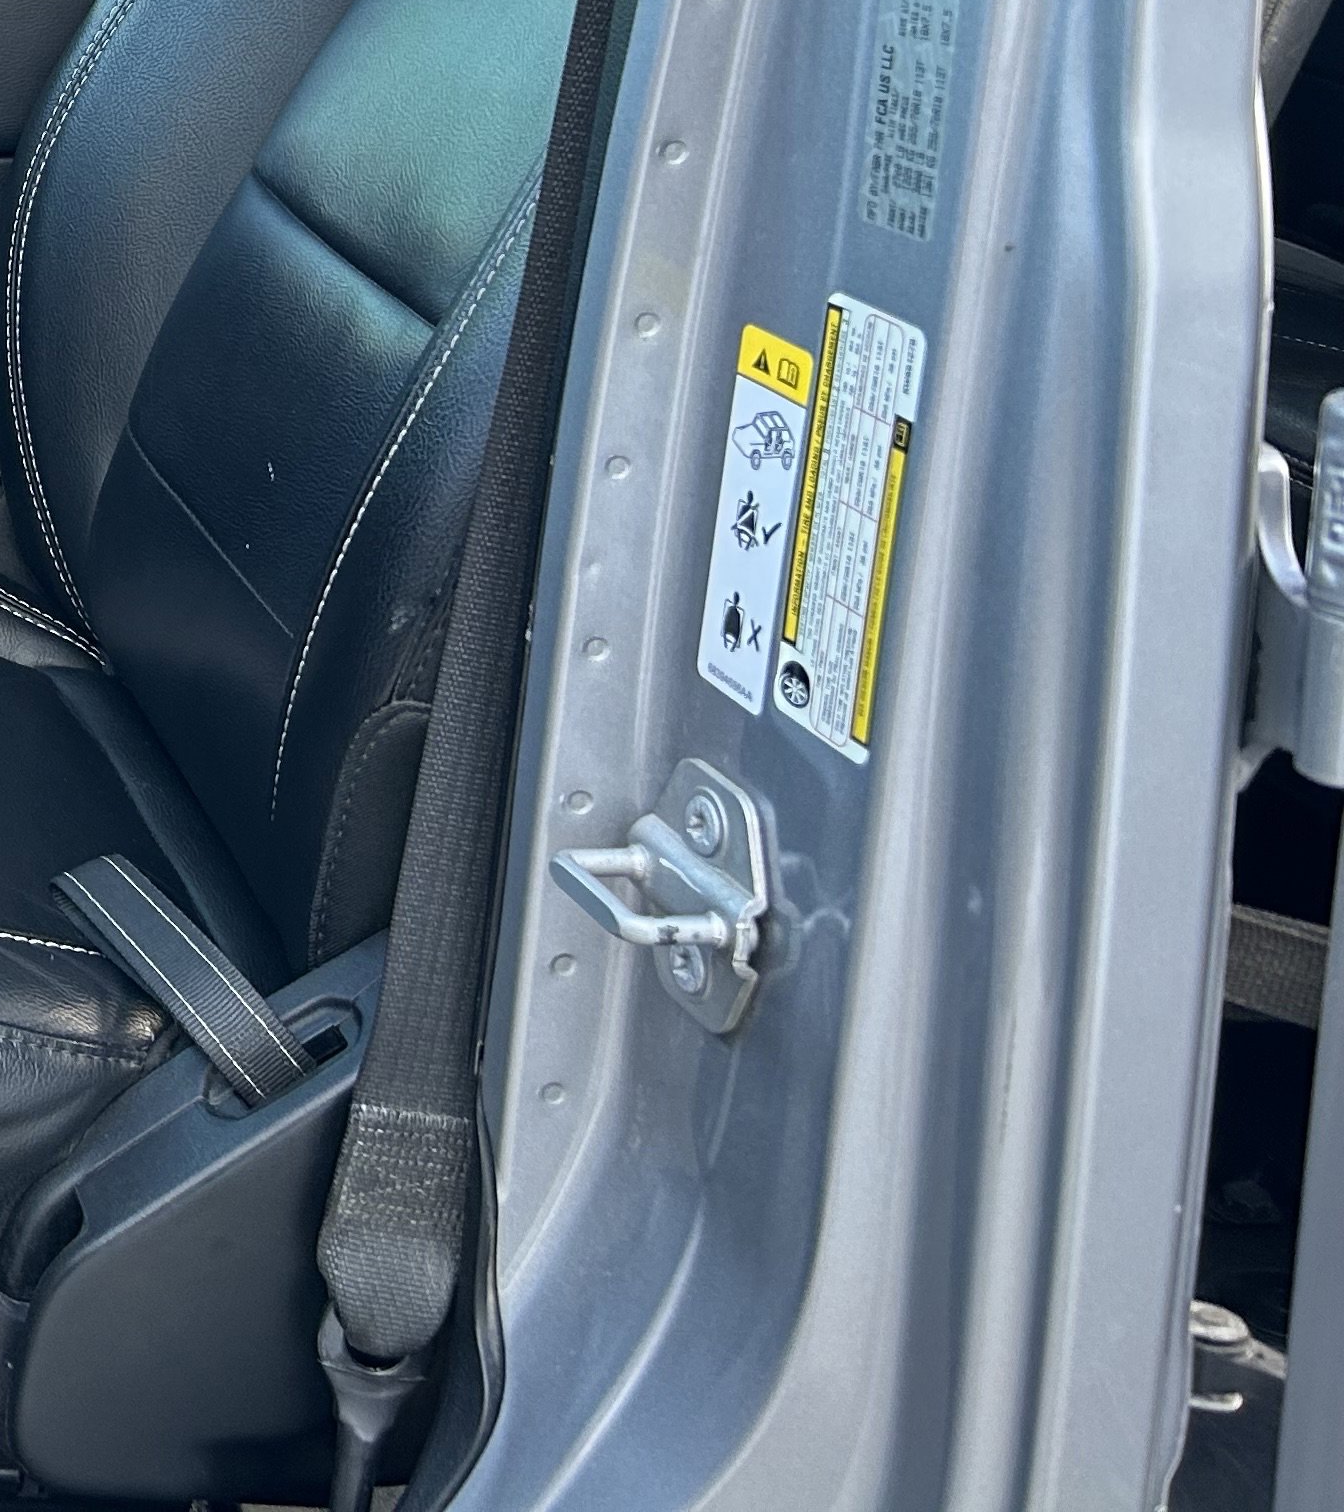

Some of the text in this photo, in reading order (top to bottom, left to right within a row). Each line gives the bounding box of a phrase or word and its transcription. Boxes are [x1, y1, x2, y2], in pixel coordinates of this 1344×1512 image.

[880, 43, 893, 71] LLC
[877, 72, 890, 94] US
[874, 96, 888, 126] FCA
